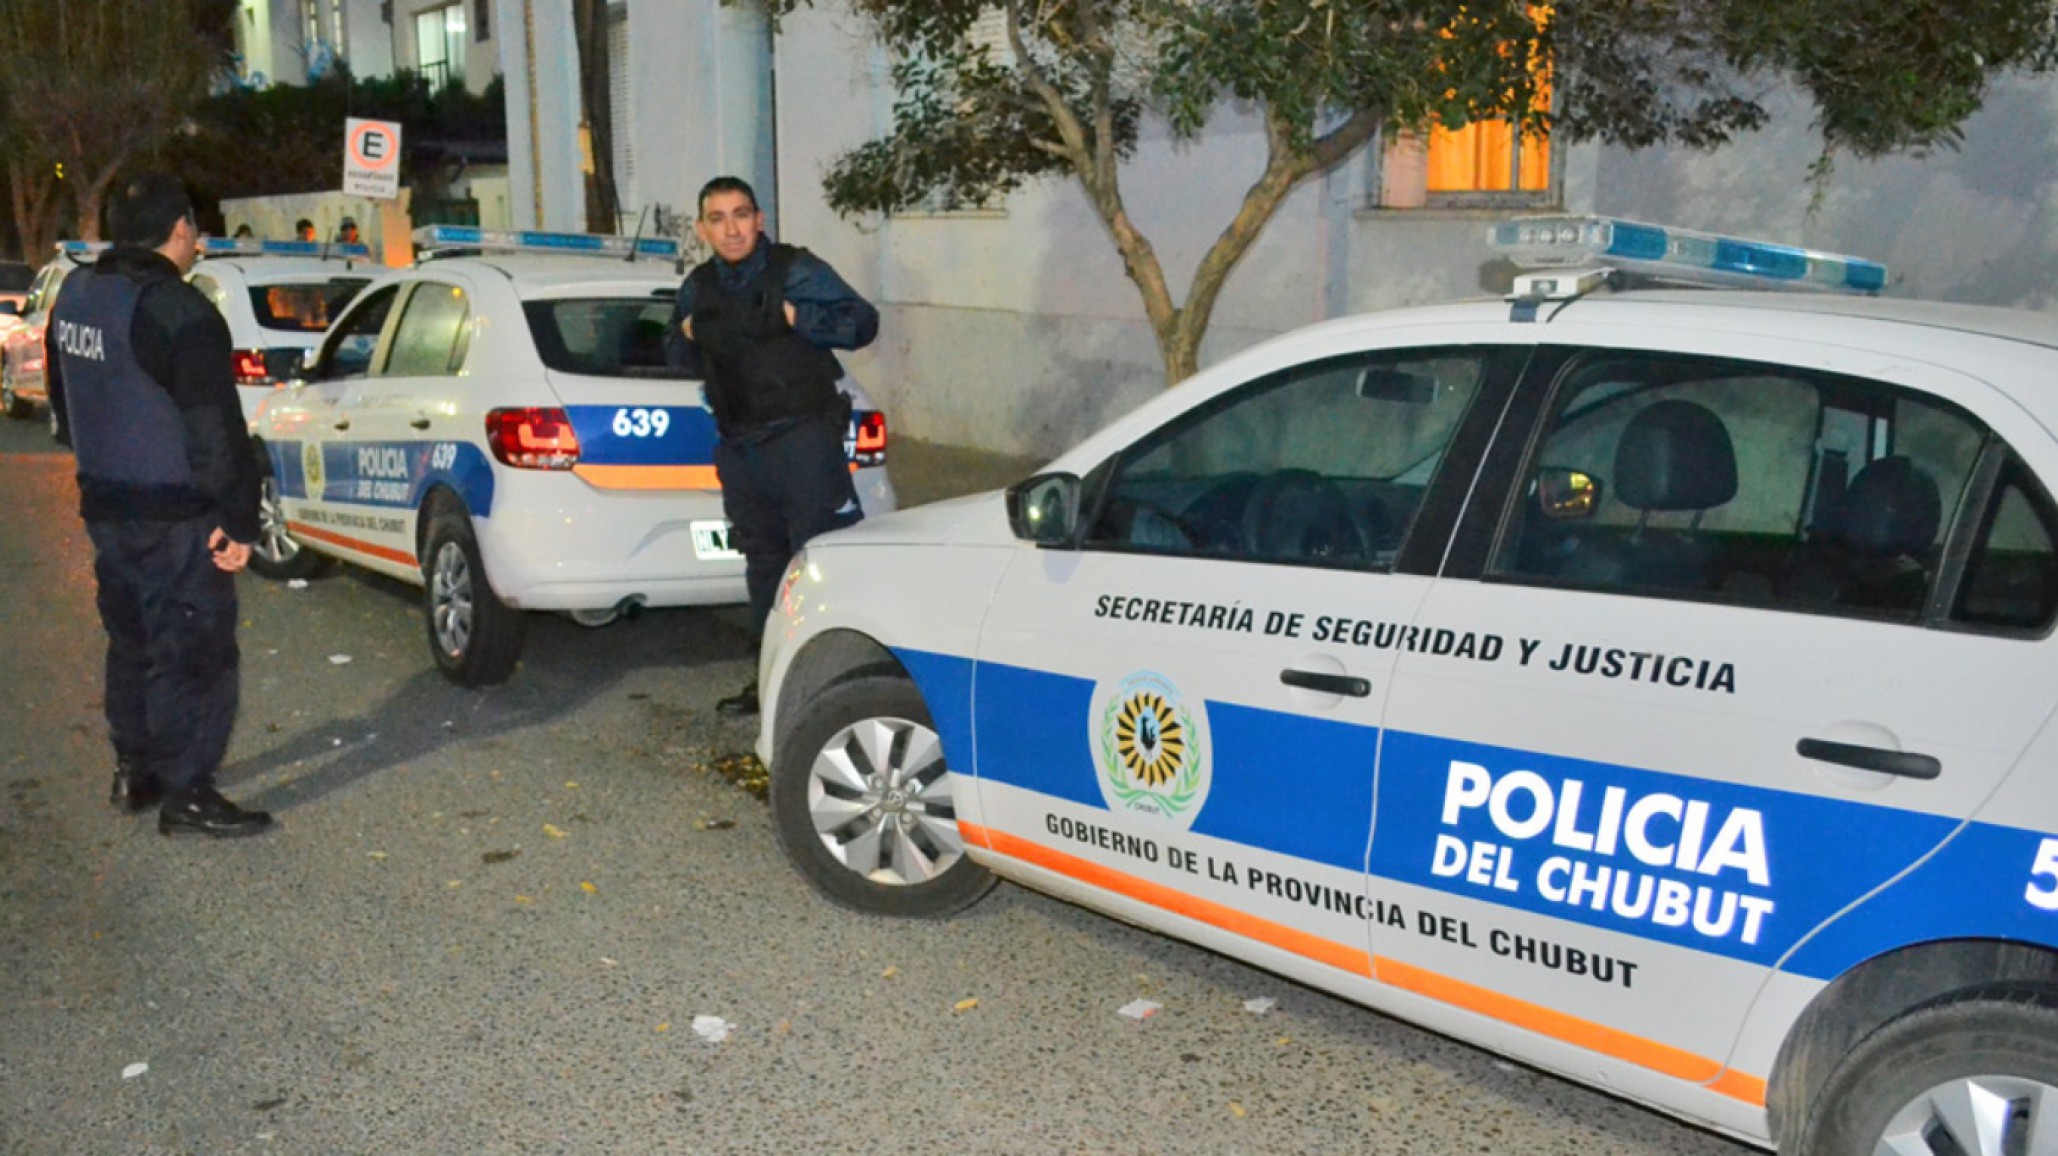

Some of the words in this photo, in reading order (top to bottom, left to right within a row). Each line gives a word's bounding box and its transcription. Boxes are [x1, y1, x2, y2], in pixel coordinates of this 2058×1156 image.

[363, 131, 383, 158] E
[59, 320, 105, 361] POLICIA
[613, 408, 670, 437] 639
[357, 447, 408, 478] POLICIA
[432, 442, 457, 470] 639
[1094, 594, 1254, 632] SECRETARÍA
[1264, 611, 1305, 638] DE
[1312, 615, 1503, 662] SEGURIDAD
[1518, 637, 1541, 666] Y
[1549, 643, 1737, 694] JUSTICIA
[1441, 759, 1771, 887] POLICIA
[1045, 812, 1159, 863] GOBIERNO
[1168, 846, 1199, 874] DE
[1208, 856, 1239, 886] LA
[1247, 867, 1406, 930] PROVINCIA
[1417, 910, 1478, 949] DEL
[1489, 928, 1639, 988] CHUBUT
[1430, 833, 1520, 892] DEL
[1536, 856, 1775, 945] CHUBUT
